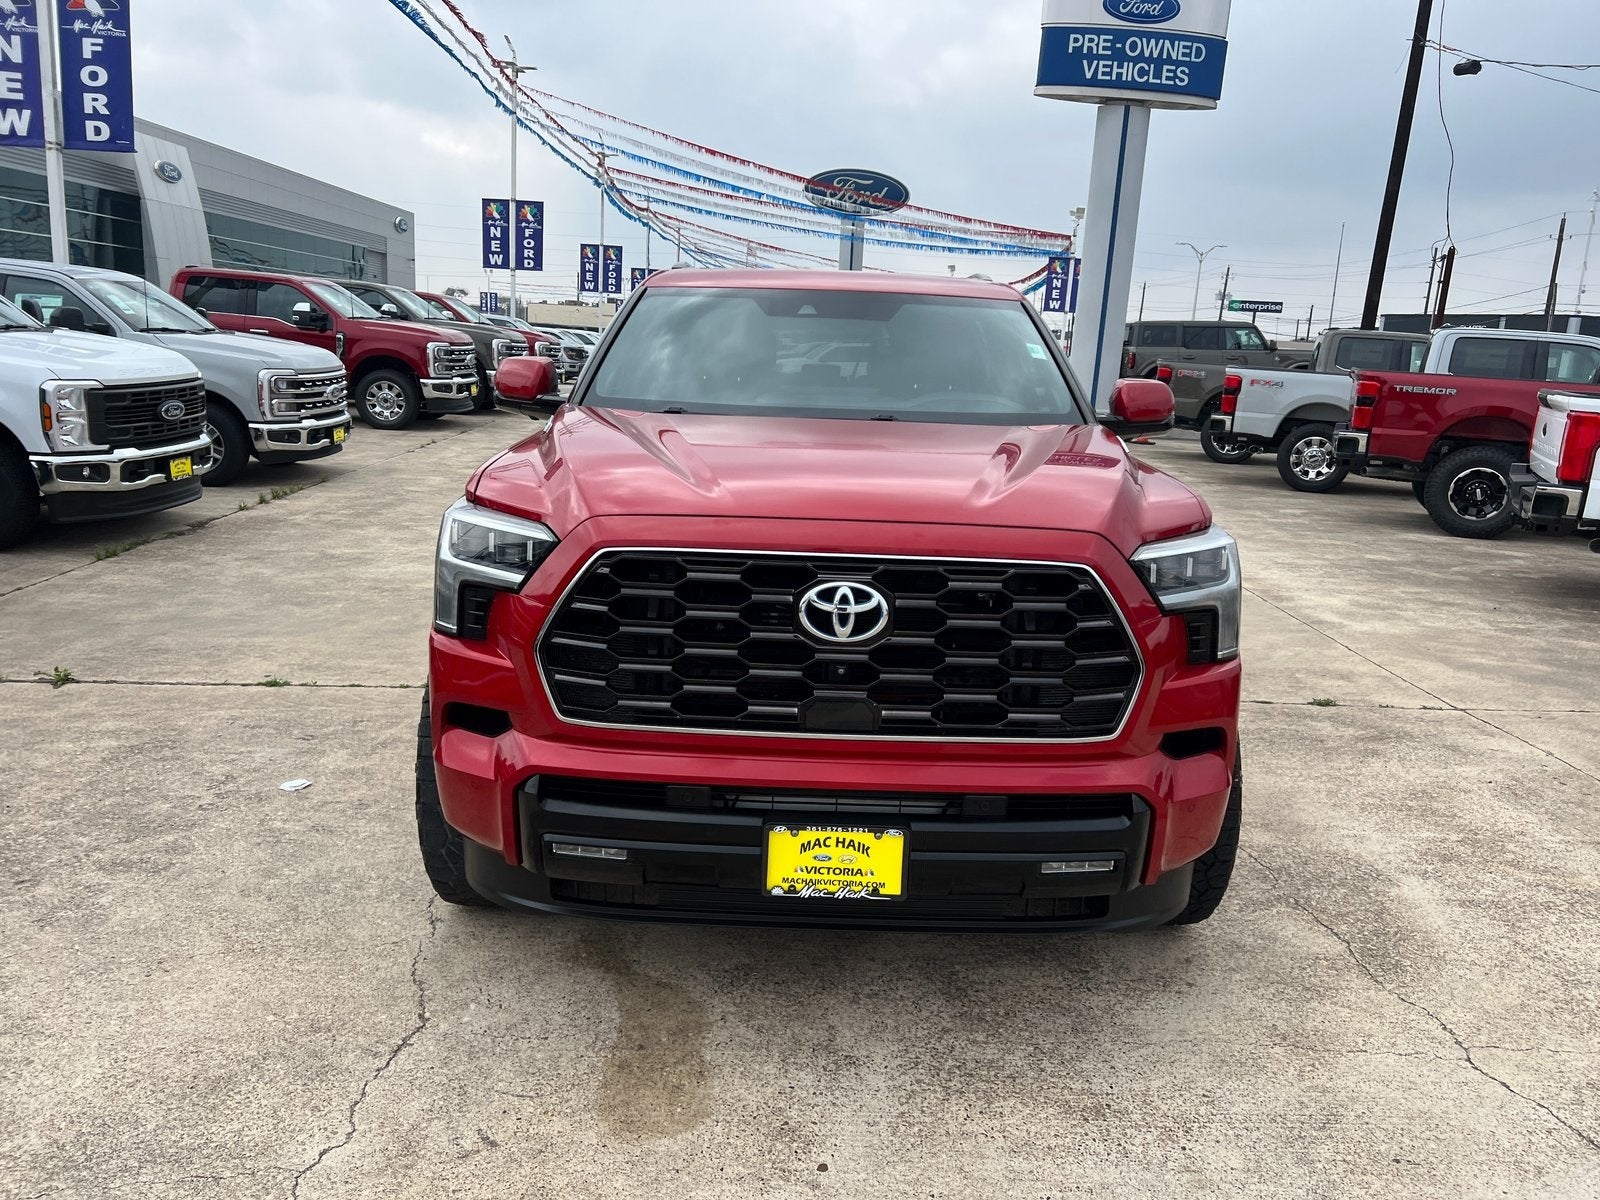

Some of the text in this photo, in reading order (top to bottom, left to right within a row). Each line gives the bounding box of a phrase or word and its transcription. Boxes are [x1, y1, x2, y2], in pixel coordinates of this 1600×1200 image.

[1119, 0, 1165, 15] Ford
[0, 34, 31, 136] NEW
[1083, 60, 1189, 86] VEHICLES
[79, 37, 111, 142] FORD
[826, 176, 889, 206] Ford
[489, 227, 503, 265] NEW
[523, 228, 535, 268] FORD
[584, 263, 595, 290] NEW
[608, 264, 616, 292] FORD
[1049, 278, 1062, 310] NEW
[1230, 301, 1282, 312] enterprise
[1393, 384, 1457, 396] TREMOR
[799, 836, 871, 858] MAC HAIK
[782, 877, 886, 888] MACHAIKVICTORIA.COM
[805, 865, 864, 877] VICTORIA
[800, 884, 878, 900] Mac Haik
